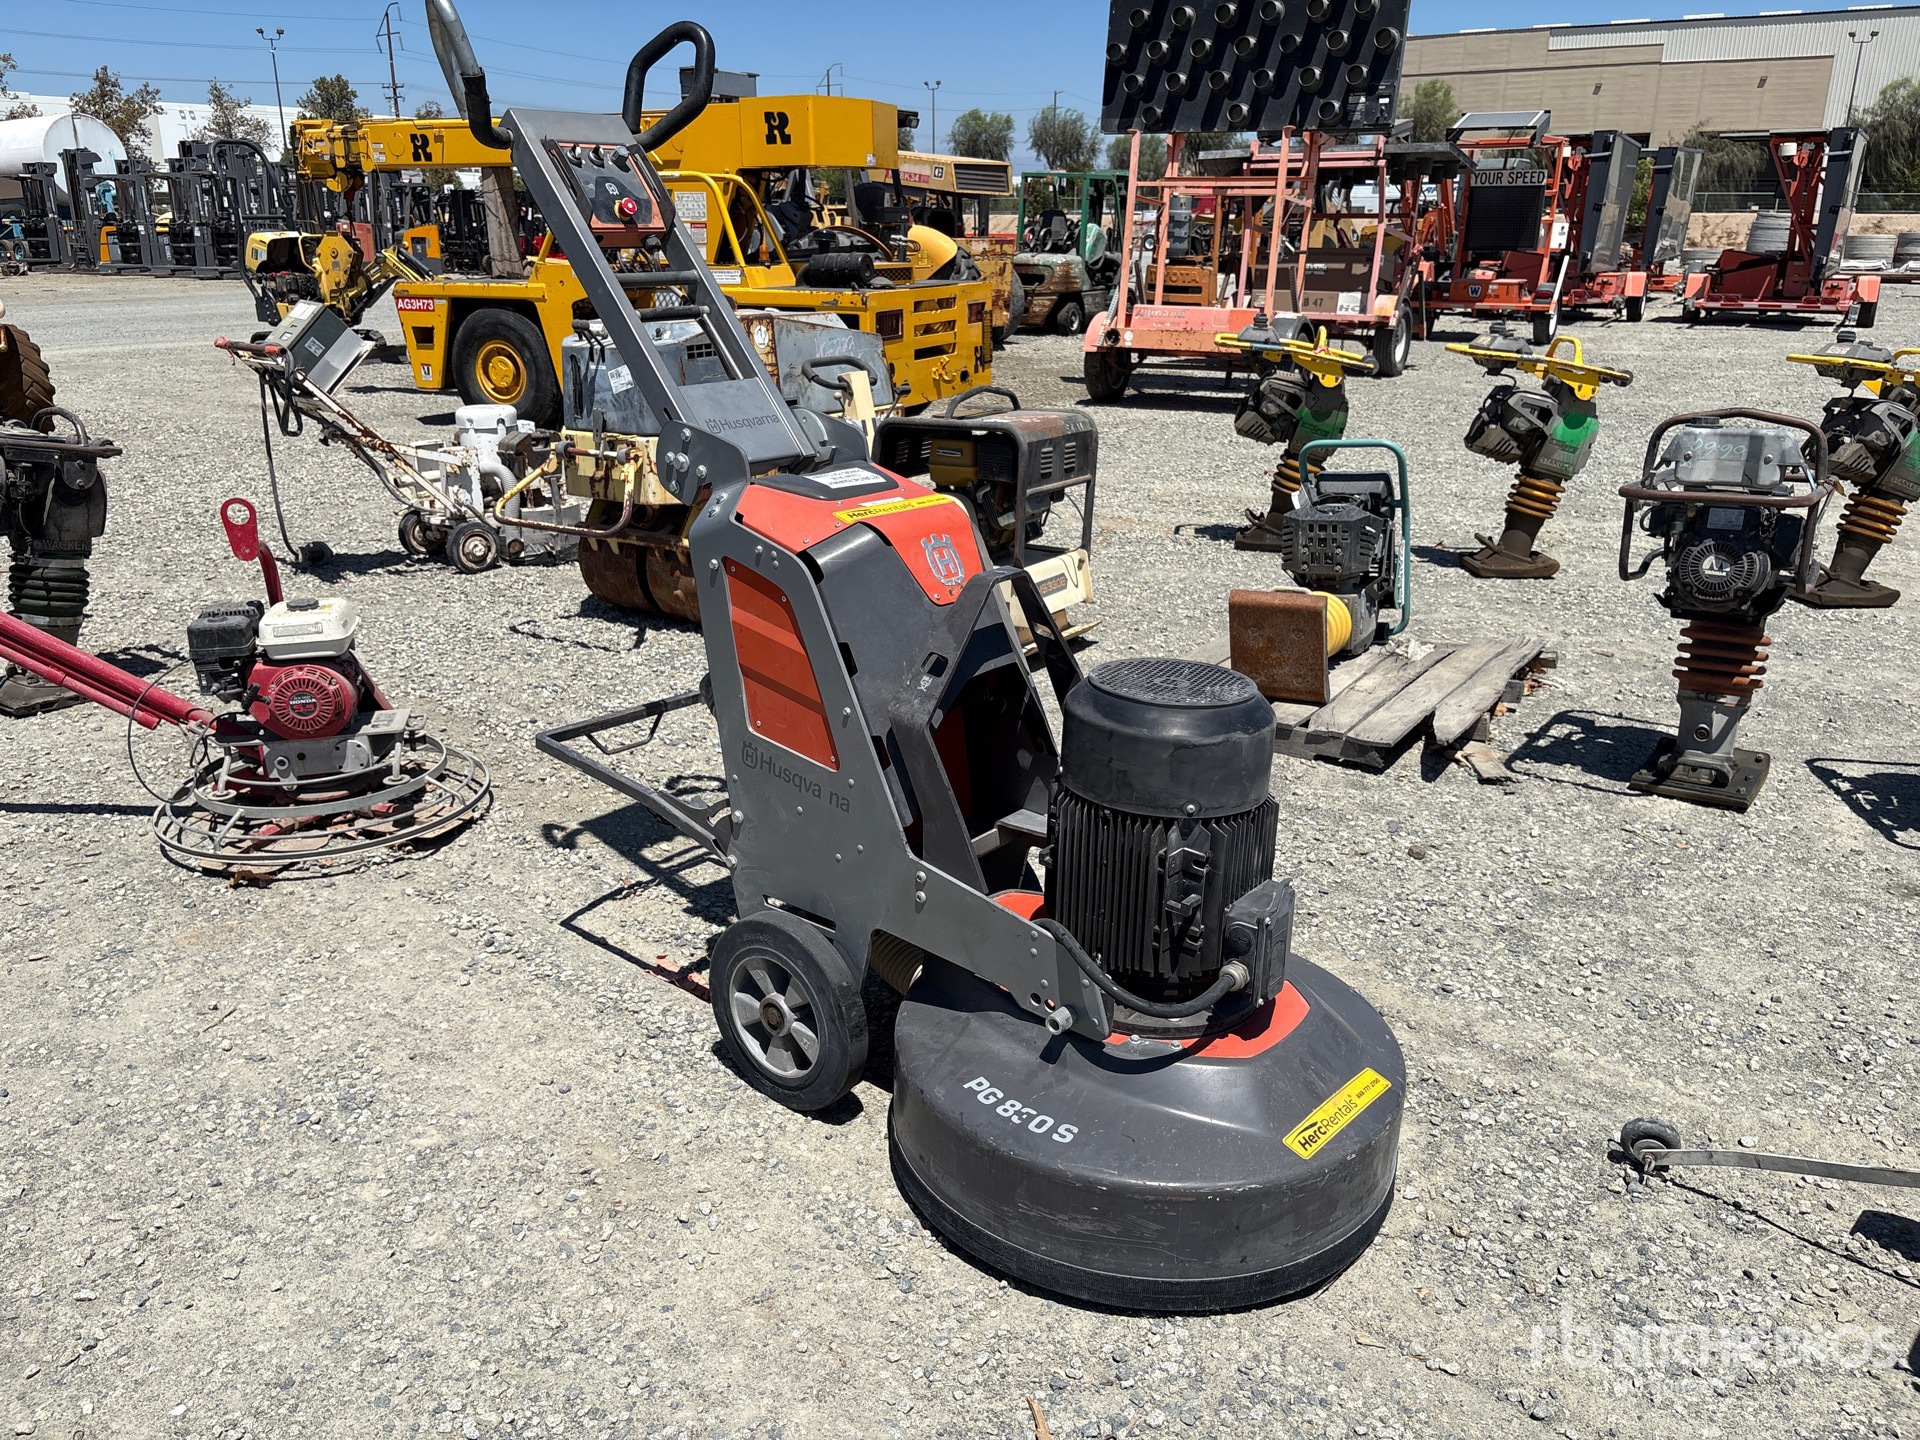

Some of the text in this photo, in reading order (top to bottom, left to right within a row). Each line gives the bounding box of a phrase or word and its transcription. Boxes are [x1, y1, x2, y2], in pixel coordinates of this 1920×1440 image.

[764, 111, 792, 145] R
[409, 133, 433, 162] R
[1473, 171, 1546, 185] YOUR SPEED
[397, 298, 434, 311] AG3H73
[719, 414, 781, 432] Husqvarna
[42, 540, 89, 551] WACKER
[289, 697, 317, 705] HONDA
